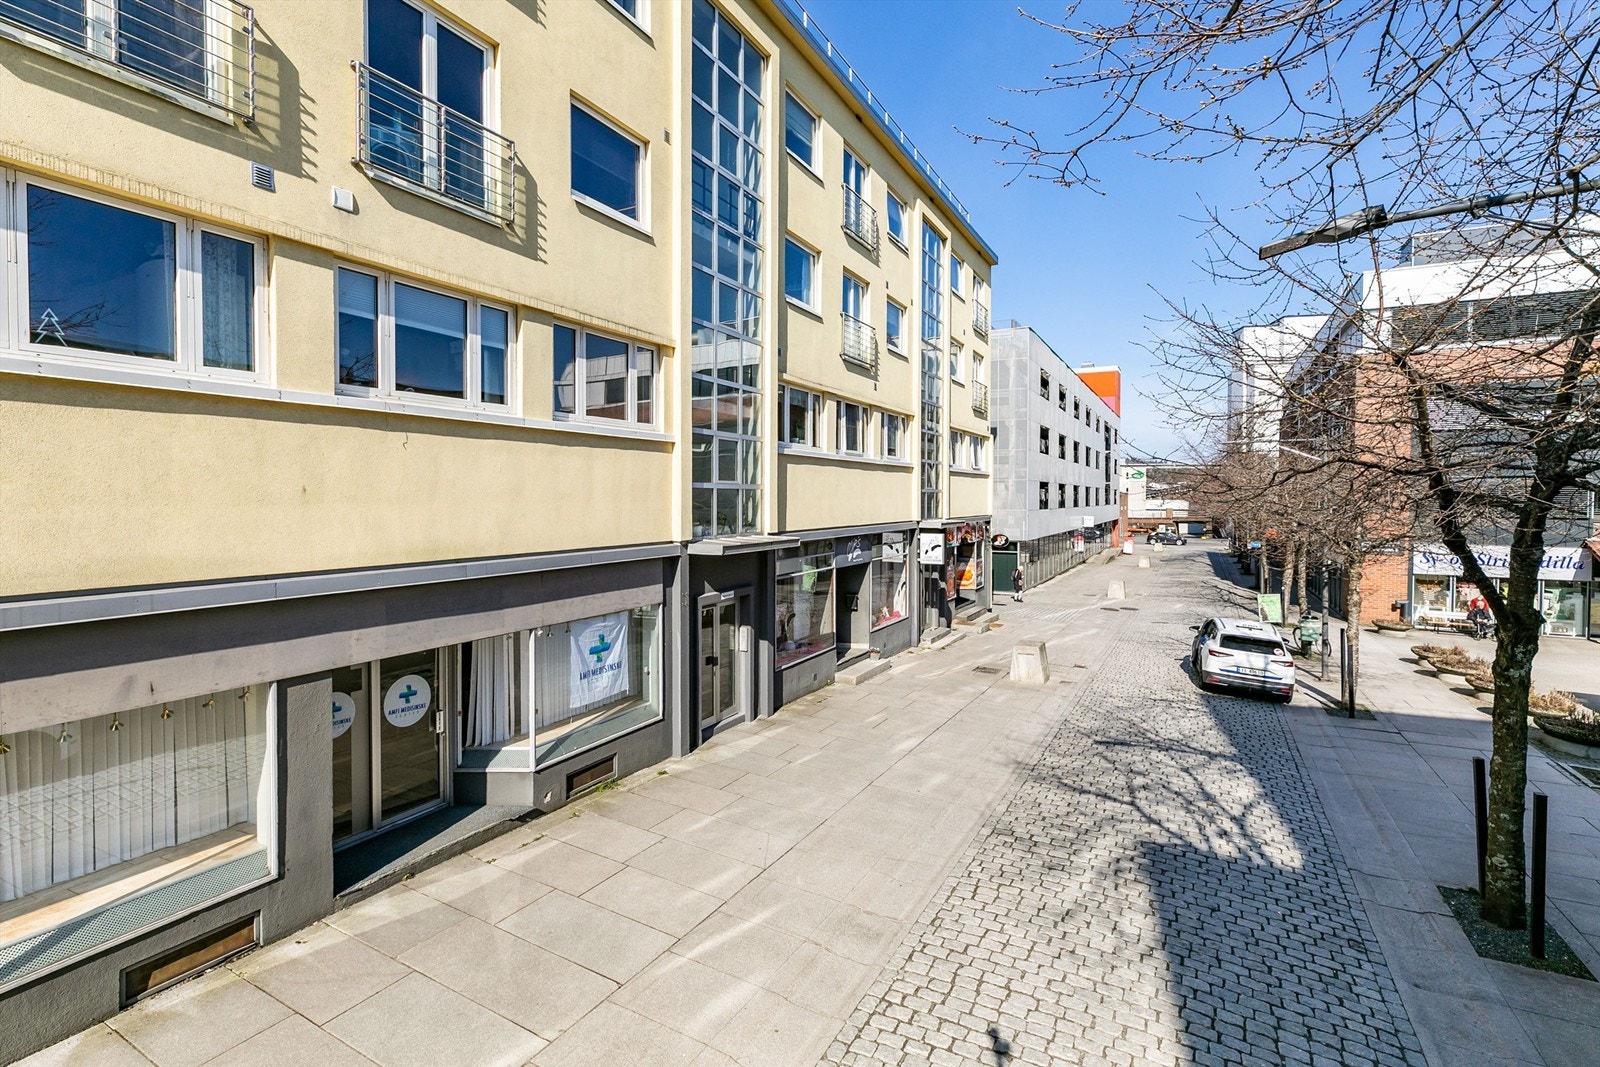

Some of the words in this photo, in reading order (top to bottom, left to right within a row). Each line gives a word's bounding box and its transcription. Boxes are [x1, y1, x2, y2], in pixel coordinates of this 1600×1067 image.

[1477, 552, 1585, 570] Stridilla
[591, 660, 622, 678] MEDISINSKE
[388, 707, 399, 716] AMFI
[401, 703, 426, 713] MEDISINSKE
